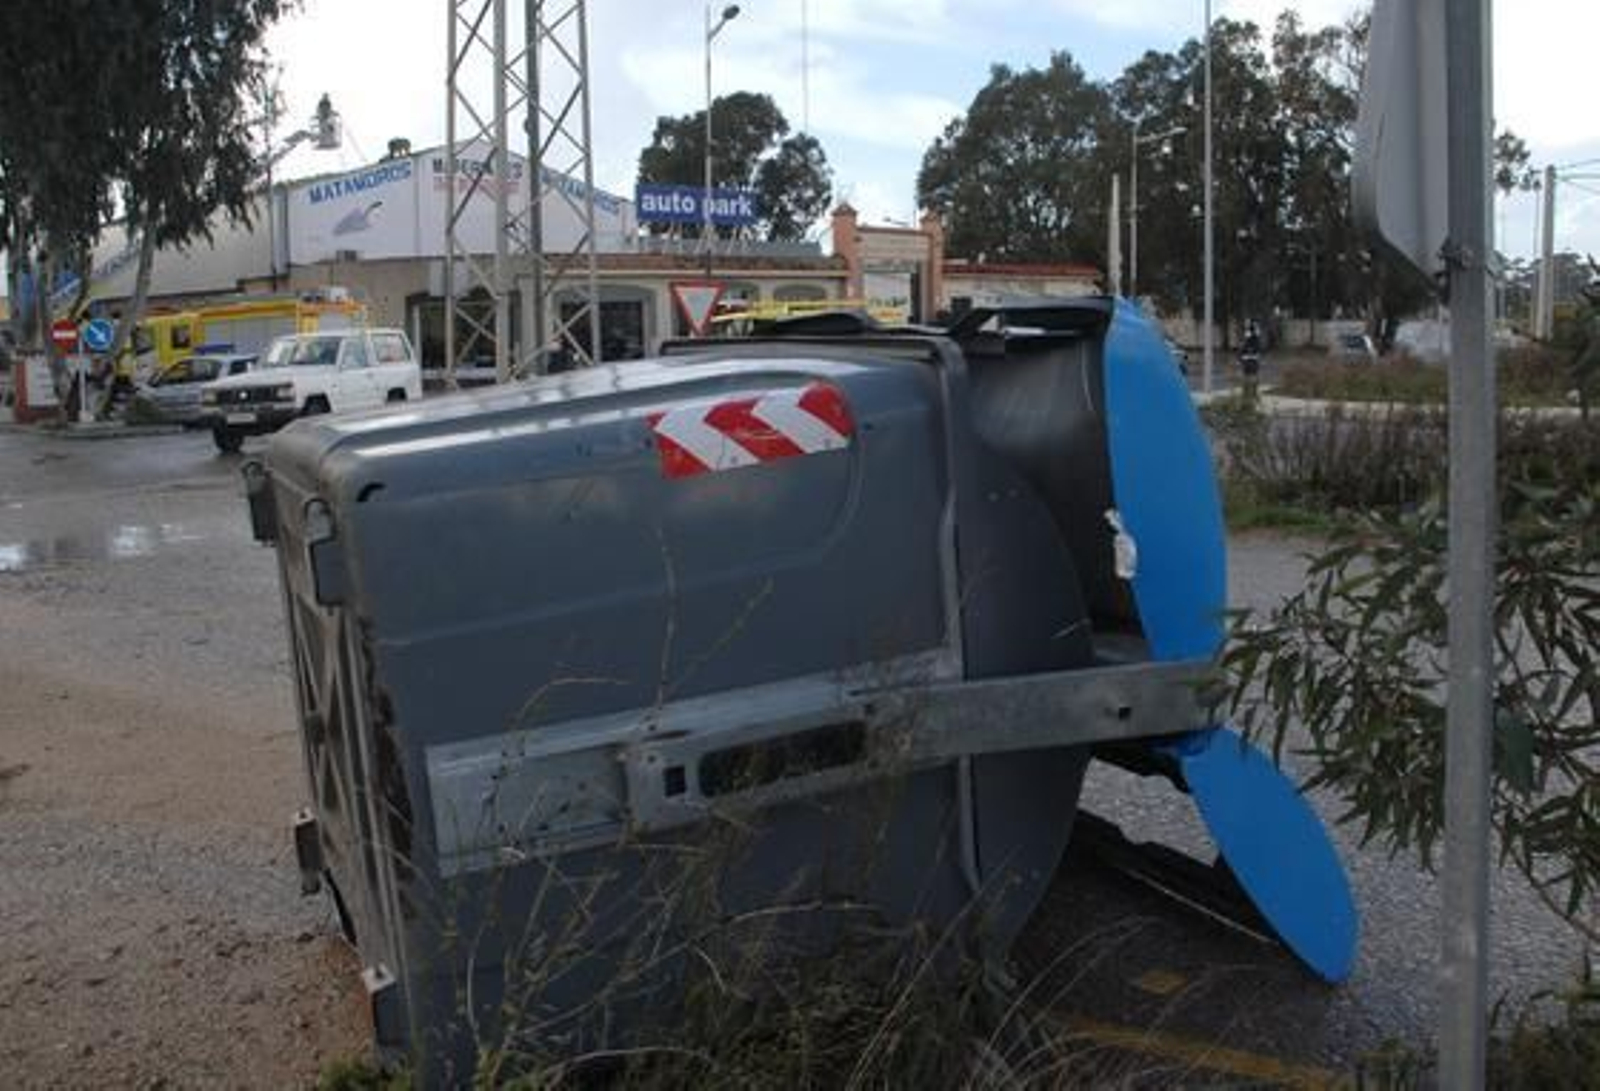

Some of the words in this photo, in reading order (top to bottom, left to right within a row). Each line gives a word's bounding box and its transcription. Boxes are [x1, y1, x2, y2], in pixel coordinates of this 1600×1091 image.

[309, 161, 412, 204] MATAMOROS
[641, 191, 696, 213] auto
[702, 194, 752, 219] park
